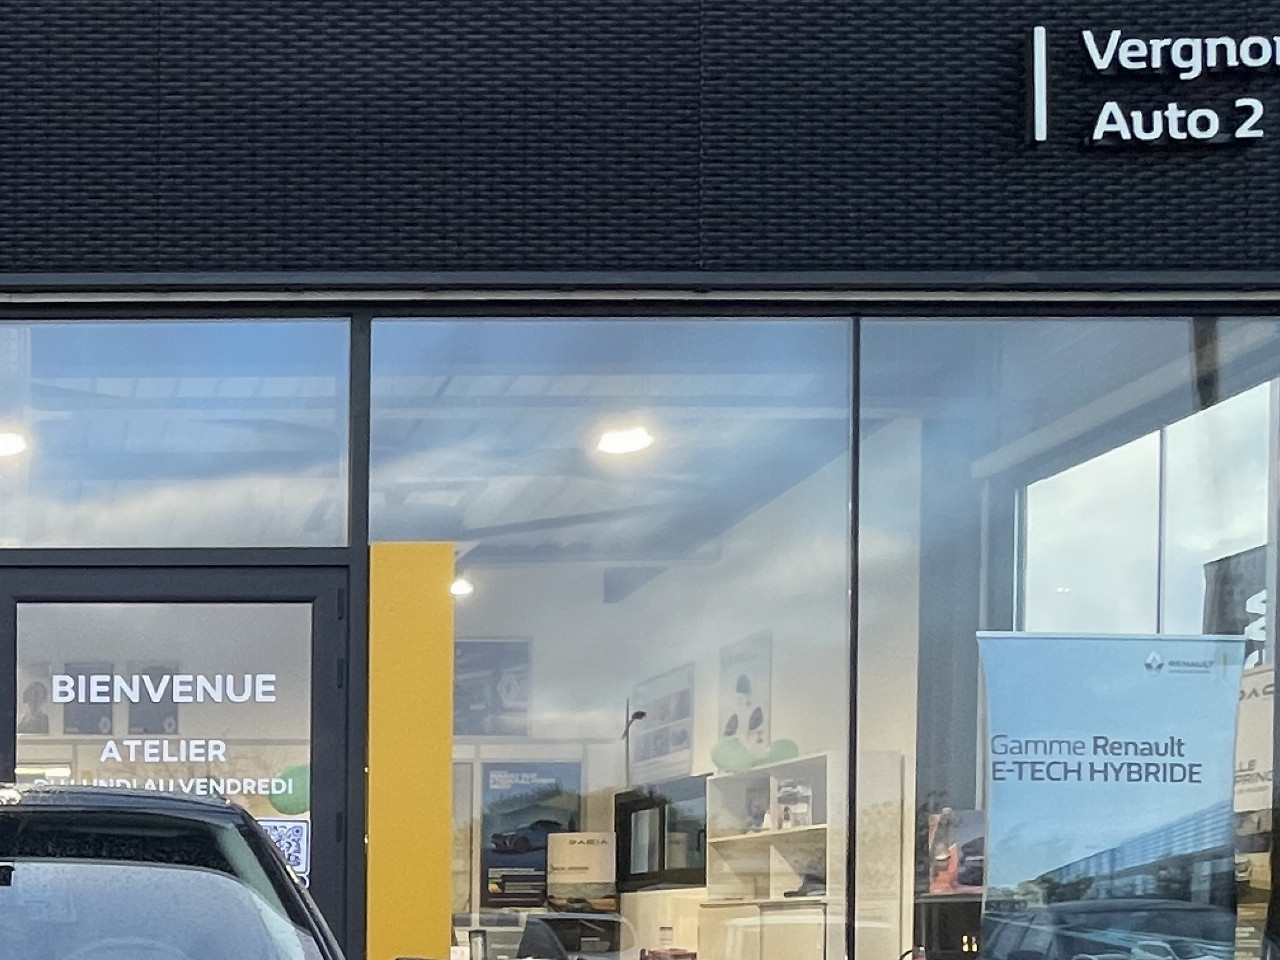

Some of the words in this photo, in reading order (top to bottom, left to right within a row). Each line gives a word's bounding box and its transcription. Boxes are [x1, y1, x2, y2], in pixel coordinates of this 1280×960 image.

[1092, 101, 1220, 140] Auto
[1234, 97, 1265, 139] 2
[51, 674, 277, 703] BIENVENUE
[100, 740, 226, 763] ATELIER
[990, 734, 1086, 756] Gamme
[1091, 736, 1187, 758] Renault
[992, 761, 1083, 782] E-TECH
[1089, 762, 1203, 783] HYBRIDE
[179, 777, 294, 796] VENDREDI
